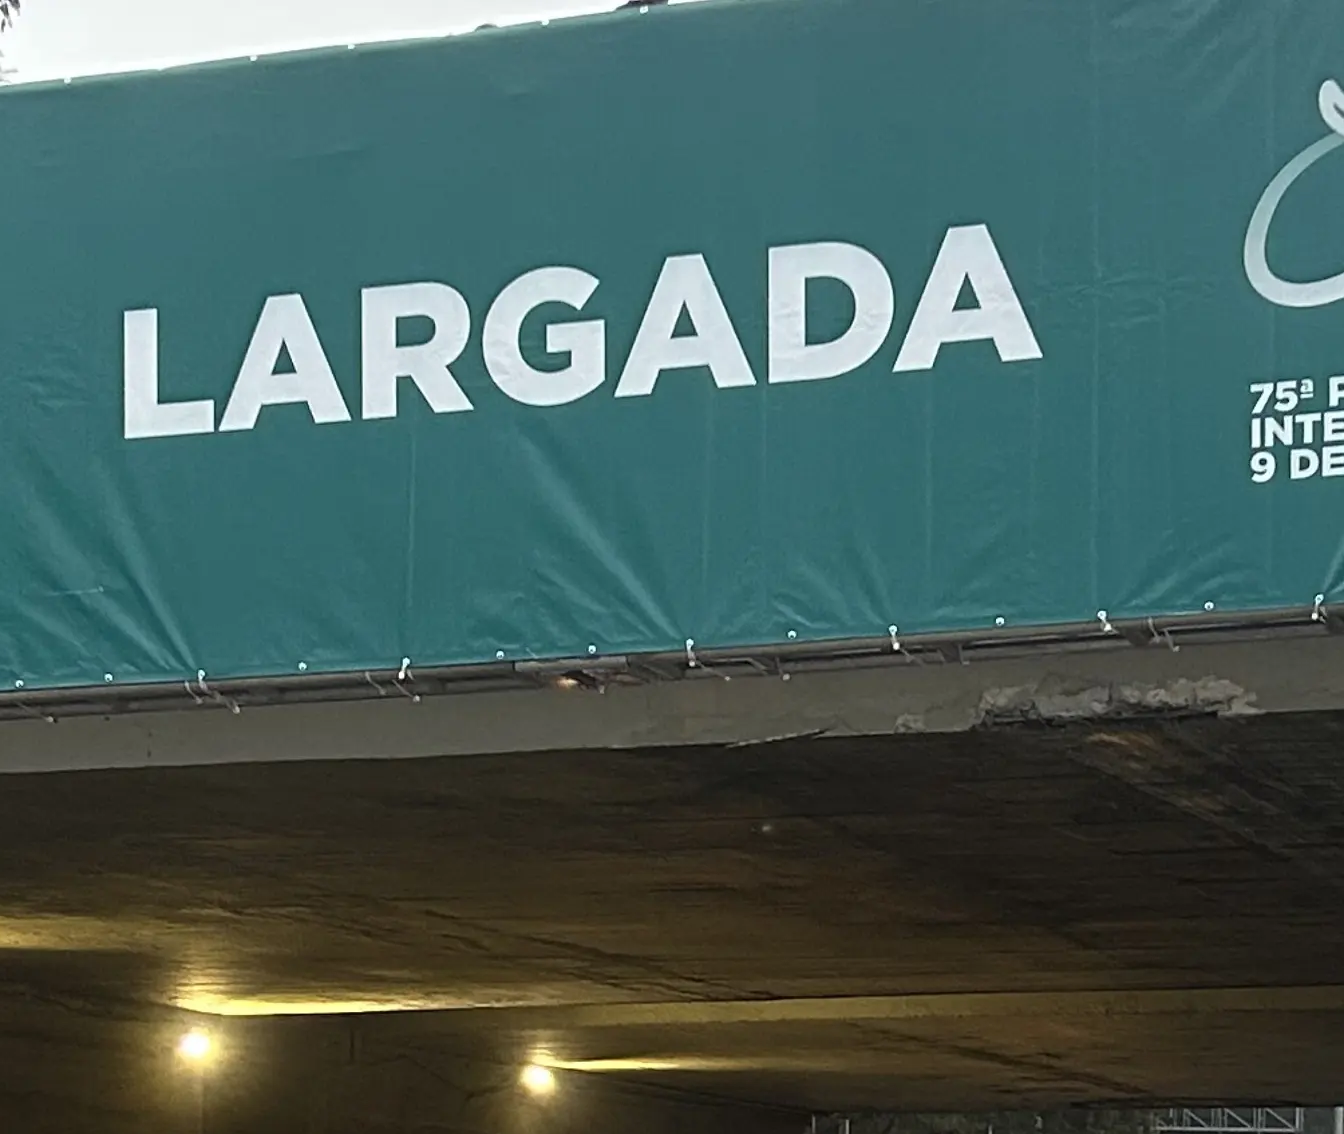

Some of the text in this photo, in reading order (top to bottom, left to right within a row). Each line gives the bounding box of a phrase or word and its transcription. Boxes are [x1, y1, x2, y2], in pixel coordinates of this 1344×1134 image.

[123, 222, 1043, 439] LARGADA
[1250, 378, 1314, 414] 75ª
[1251, 455, 1275, 482] 9
